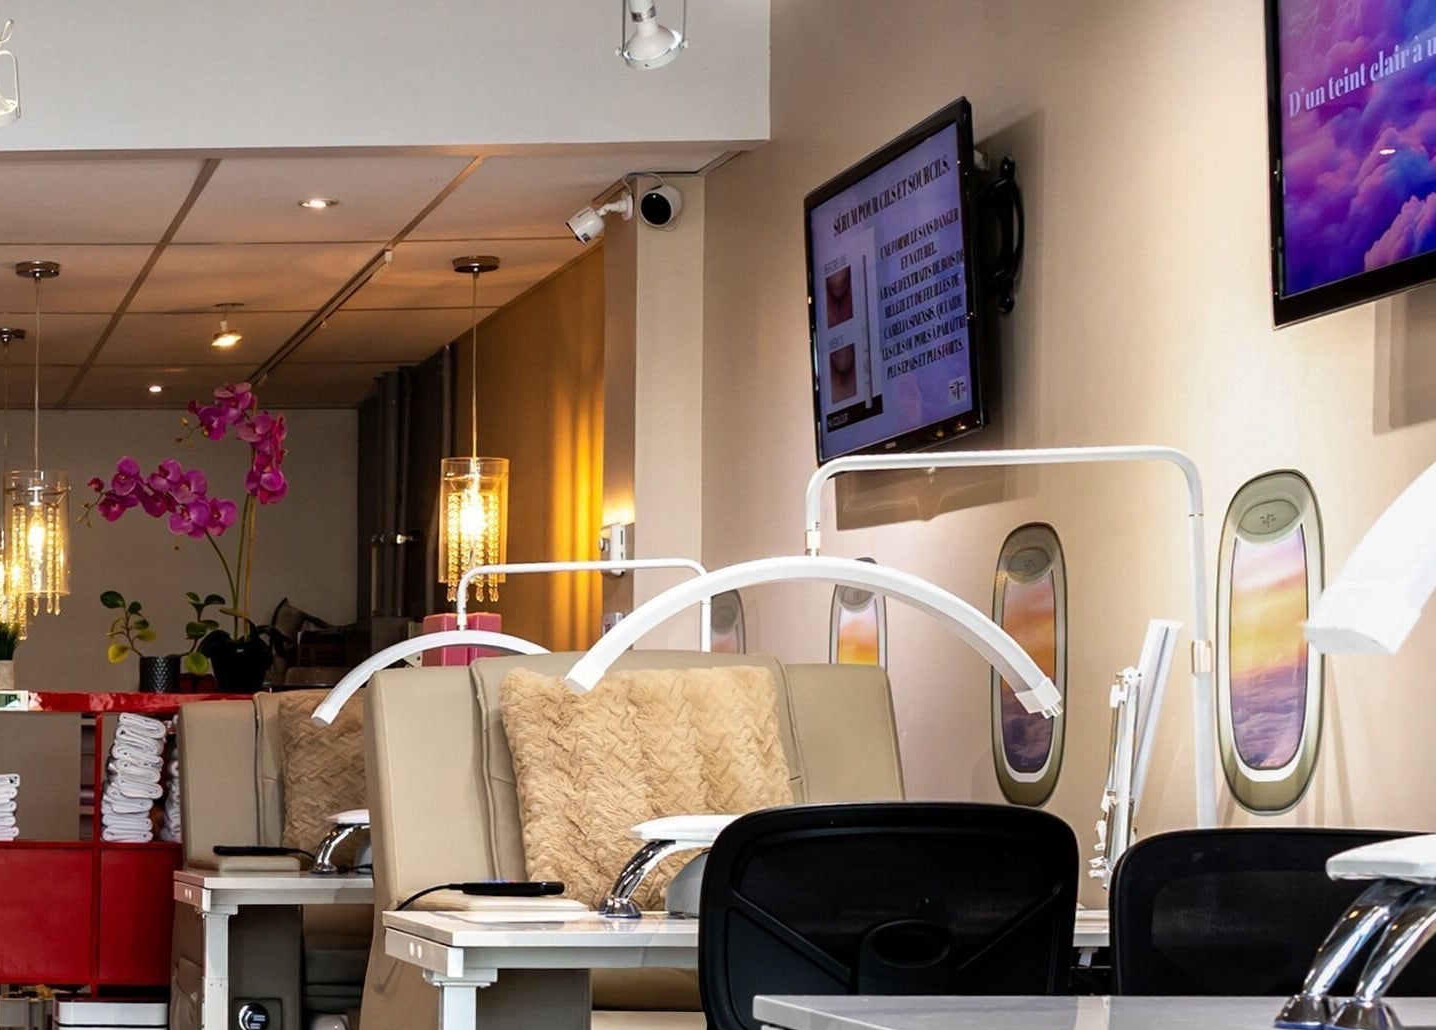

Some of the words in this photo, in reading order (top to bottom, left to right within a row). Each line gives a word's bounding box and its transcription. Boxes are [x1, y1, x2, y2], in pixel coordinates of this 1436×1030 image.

[1289, 87, 1326, 118] D'un
[1328, 62, 1366, 101] teint
[1370, 45, 1409, 81] clair
[1413, 34, 1423, 64] à
[833, 207, 857, 236] SÉRUM
[858, 195, 878, 222] POUR
[879, 185, 896, 210] CILS
[897, 178, 906, 200] ET
